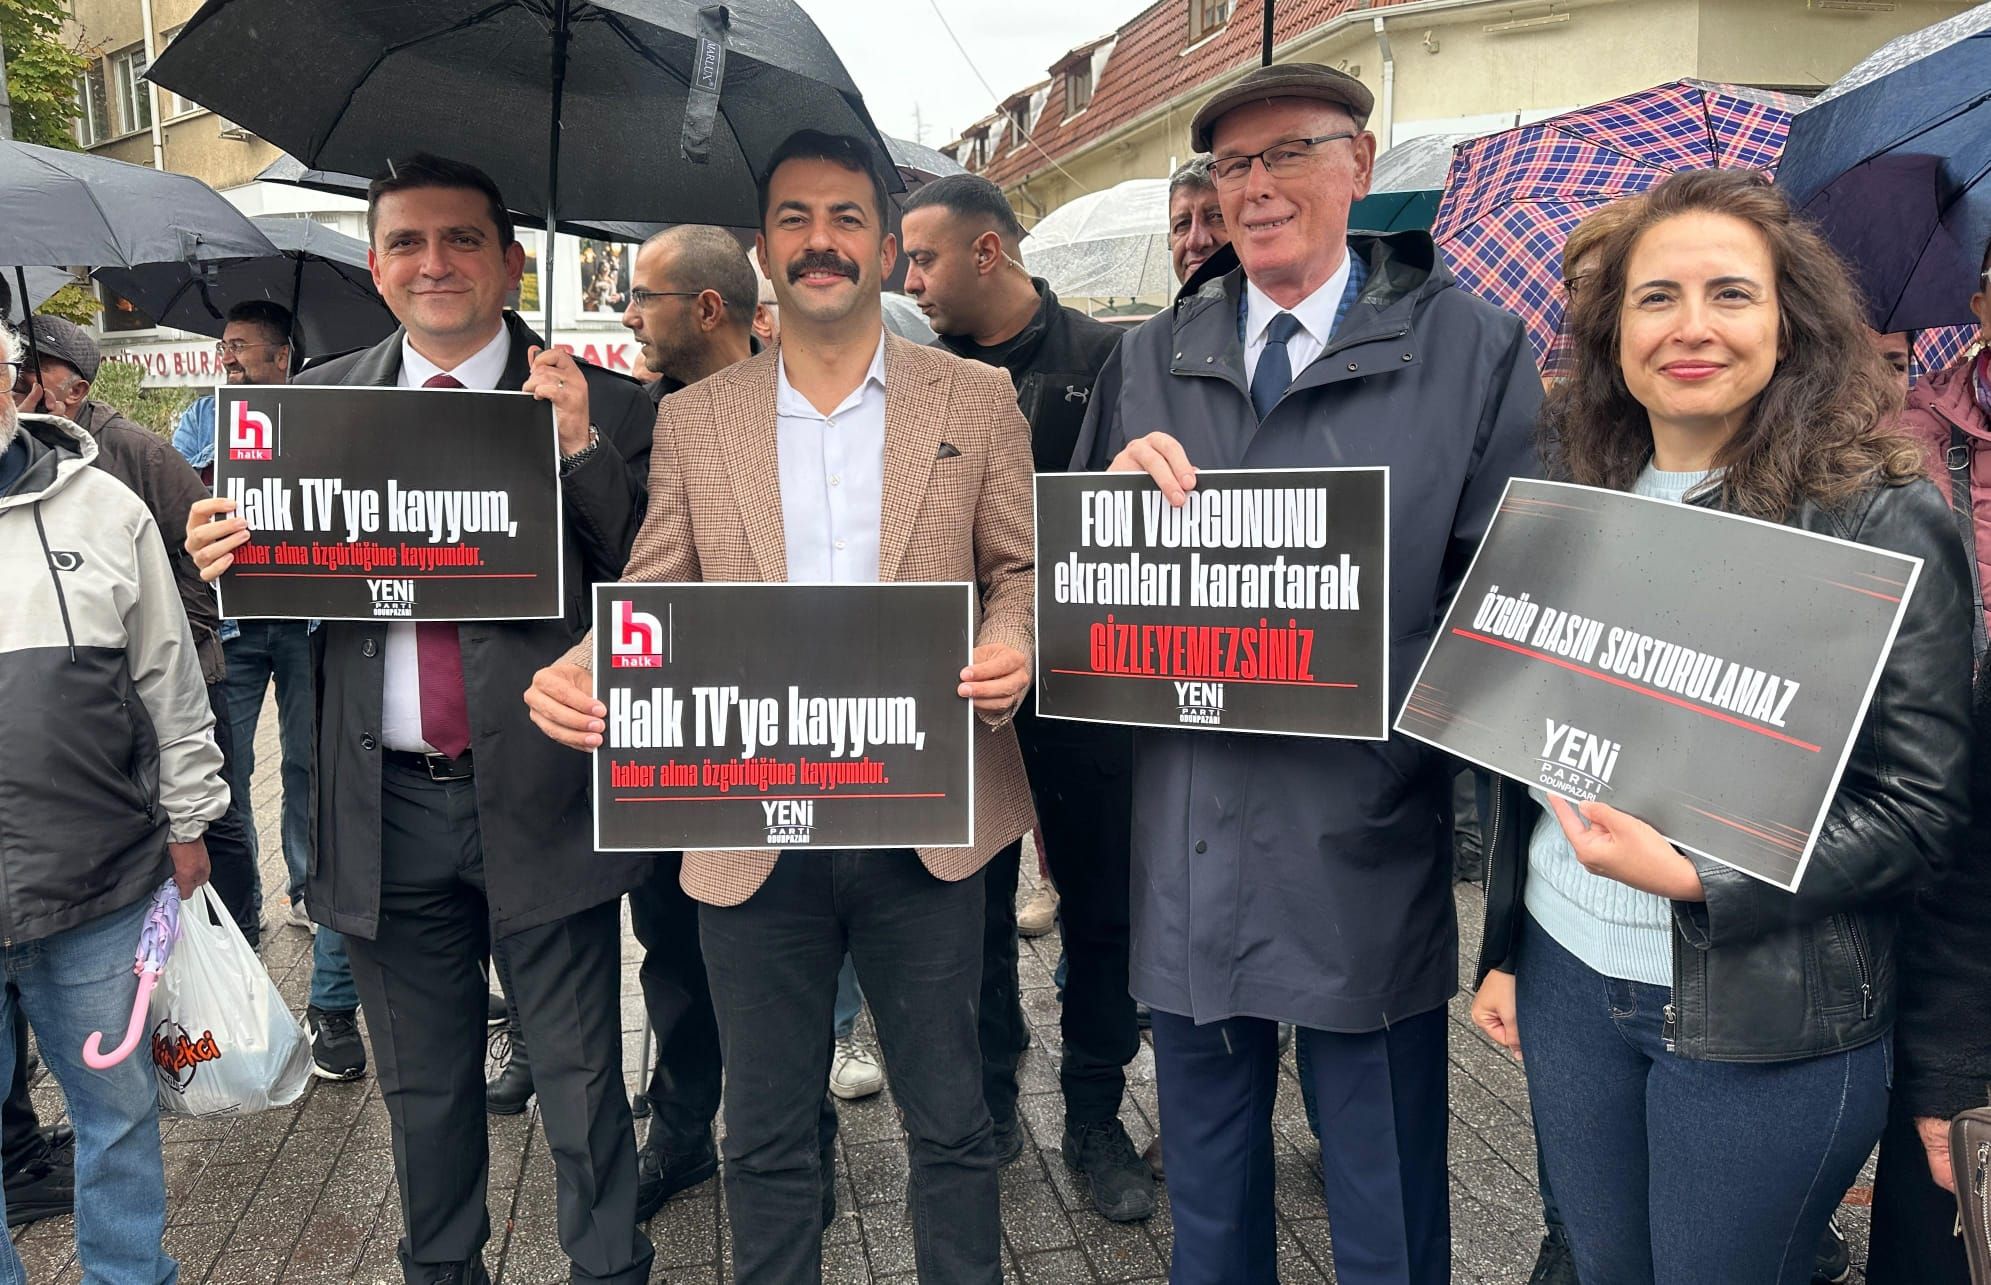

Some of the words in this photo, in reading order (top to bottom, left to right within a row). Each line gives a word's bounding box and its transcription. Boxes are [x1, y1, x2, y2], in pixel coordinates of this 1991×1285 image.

[174, 351, 223, 376] BURA
[237, 450, 263, 459] halk
[227, 477, 293, 531] Halk
[387, 479, 518, 543] kayyum,
[1081, 490, 1133, 548] FON
[1141, 488, 1327, 549] VURGUNUNU
[275, 541, 309, 565] alma
[312, 541, 397, 572] özgürlüğüne
[401, 542, 485, 572] kayyumdur.
[1055, 551, 1181, 607] ekranları
[1190, 552, 1360, 611] karartarak
[621, 656, 652, 667] halk
[1090, 614, 1315, 682] GİZLEYEMEZSİNİZ
[1473, 585, 1539, 643] ÖZGÜR
[1531, 606, 1605, 664] BASIN
[1598, 626, 1801, 728] SUSTURULAMAZ
[609, 687, 683, 749] Halk
[788, 685, 926, 758] kayyum,
[611, 760, 655, 788] haber
[660, 759, 698, 787] alma
[703, 756, 796, 792] özgürlüğüne
[800, 756, 889, 790] kayyumdur.
[1540, 774, 1597, 801] ODUNPAZARI
